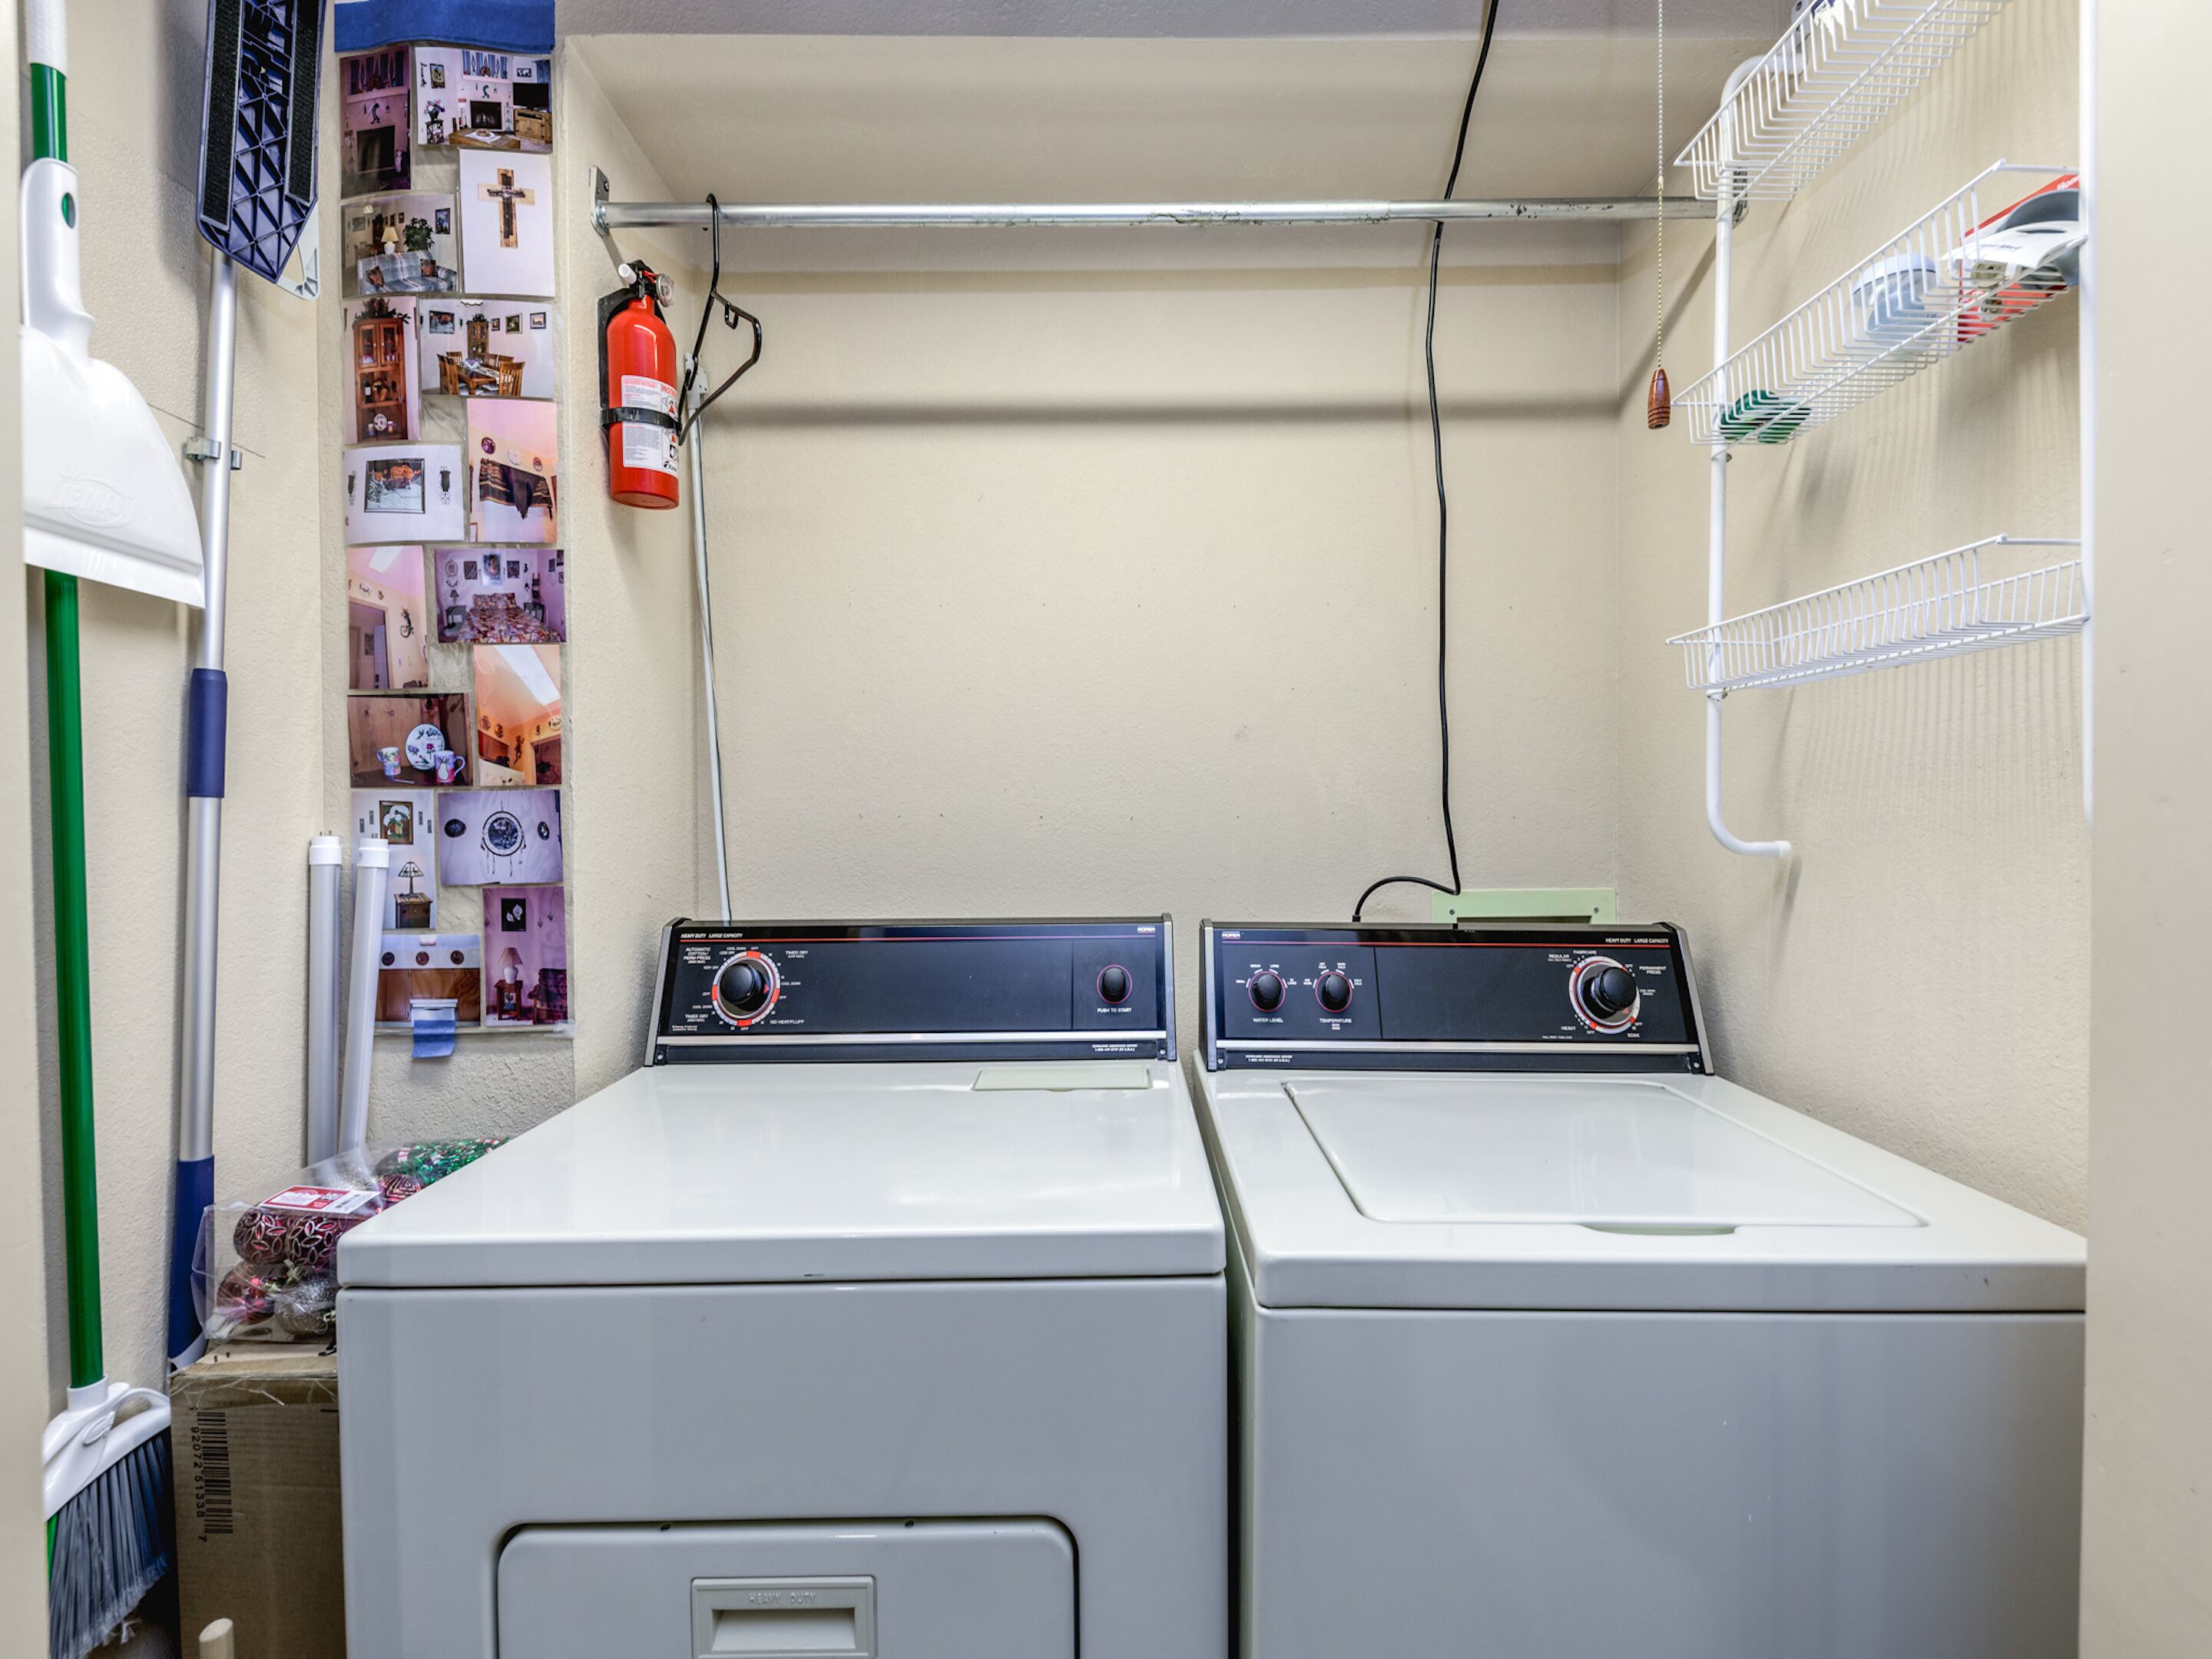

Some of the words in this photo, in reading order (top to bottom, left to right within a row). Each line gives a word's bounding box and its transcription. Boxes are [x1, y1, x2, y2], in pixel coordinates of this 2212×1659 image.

[190, 1426, 203, 1469] 92072
[194, 1475, 206, 1518] 51338
[748, 1592, 782, 1605] HEAVY
[790, 1591, 816, 1604] DUTY
